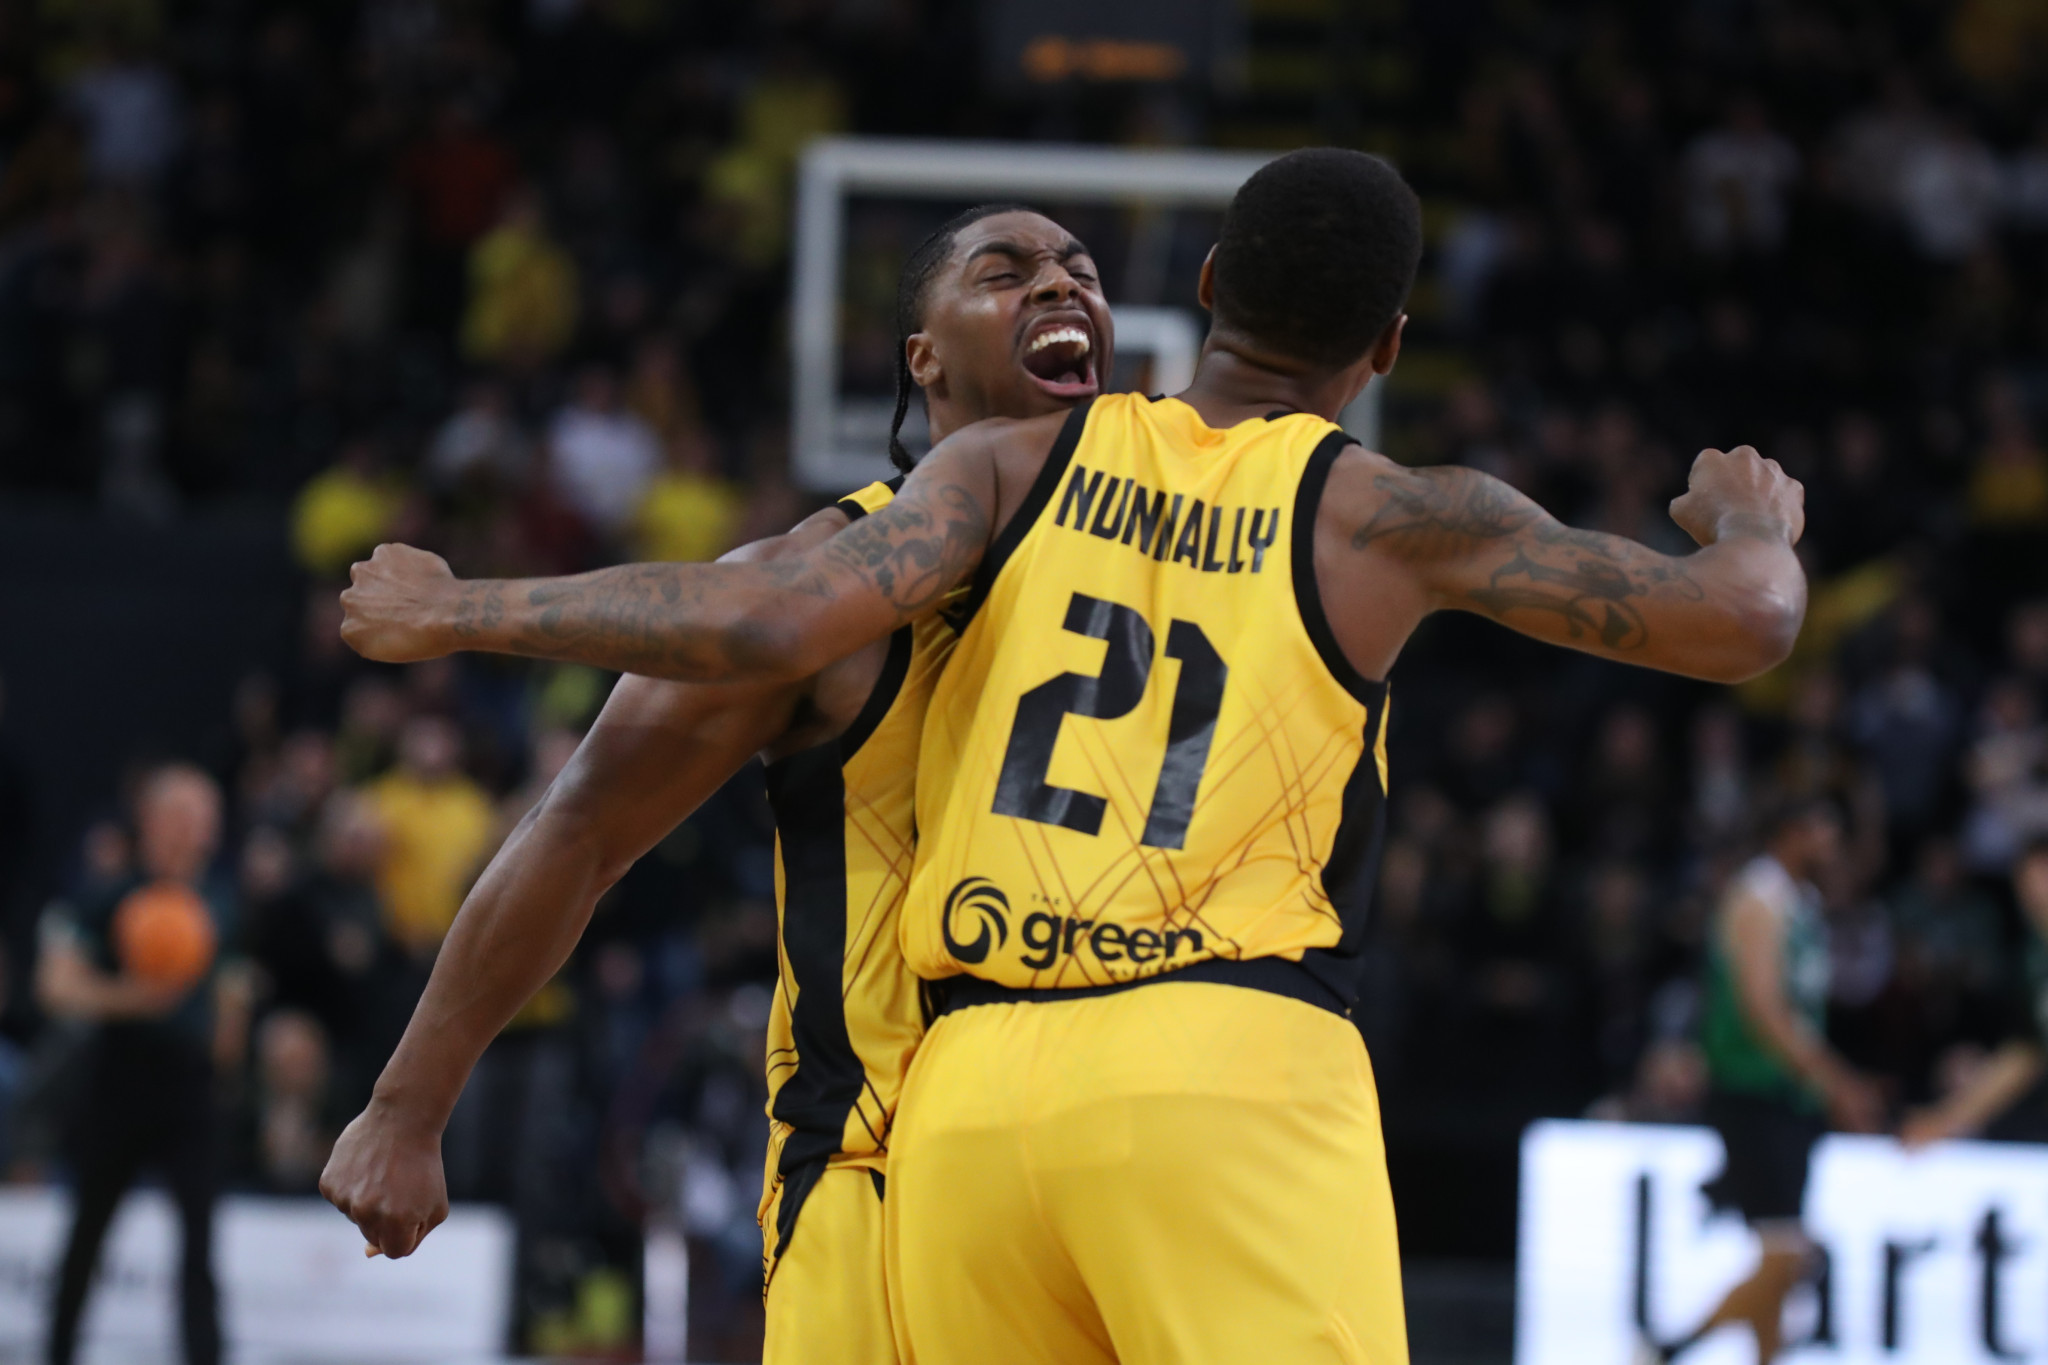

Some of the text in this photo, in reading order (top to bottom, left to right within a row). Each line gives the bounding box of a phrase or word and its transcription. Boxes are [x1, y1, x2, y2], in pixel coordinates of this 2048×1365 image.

[1055, 465, 1280, 573] NUNNALLY
[991, 592, 1228, 850] 21
[1020, 910, 1204, 970] green
